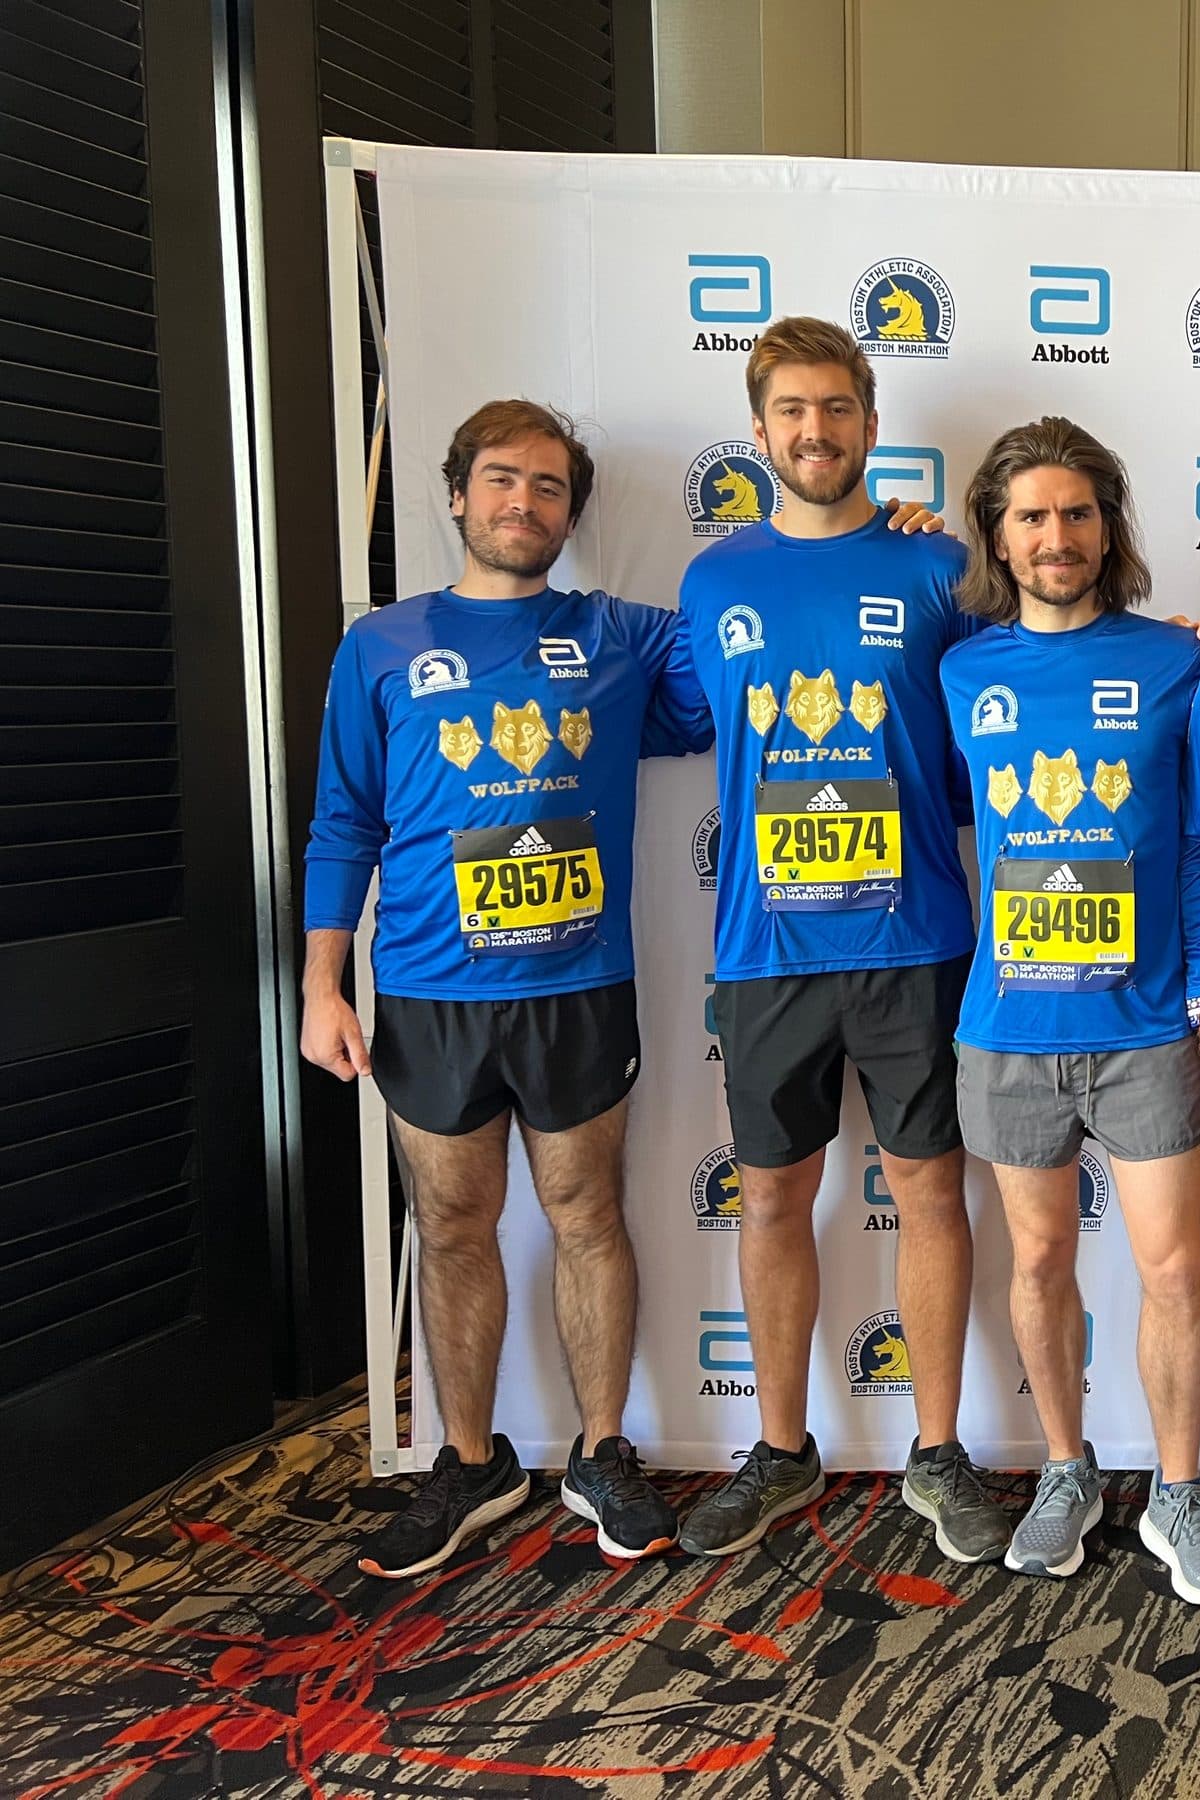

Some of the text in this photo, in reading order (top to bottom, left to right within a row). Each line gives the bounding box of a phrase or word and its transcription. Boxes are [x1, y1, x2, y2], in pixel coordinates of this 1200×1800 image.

[853, 261, 952, 336] BOSTON ATHLETIC ASSOCIATION
[692, 332, 759, 352] Abbo
[858, 342, 949, 355] BOSTON MARATHON
[1031, 344, 1110, 365] Abbott
[688, 472, 701, 514] BOSTON
[698, 444, 748, 469] ATHLETIC
[692, 523, 729, 534] BOSTON
[860, 635, 904, 649] Abbott
[549, 667, 589, 679] Abbott
[1093, 719, 1139, 730] Abbott
[763, 747, 872, 765] WOLFPACK
[467, 775, 579, 799] WOLFPACK
[806, 801, 848, 811] adidas
[770, 816, 888, 863] 29574
[1007, 828, 1114, 847] WOLFPACK
[509, 843, 553, 856] adidas
[696, 827, 710, 869] BOSTON
[764, 866, 799, 880] 6 V
[472, 854, 592, 911] 29575
[699, 879, 717, 887] BOS
[1042, 882, 1084, 892] adidas
[786, 891, 845, 900] MARATHON
[467, 914, 499, 927] 6 V
[1007, 896, 1121, 943] 29496
[513, 927, 551, 938] BOSTON
[491, 935, 552, 947] MARATHON
[999, 943, 1034, 958] 6 V
[1019, 971, 1076, 981] MARATHON
[1039, 965, 1075, 973] BOSTON
[694, 1146, 736, 1210] BOSTON ATHLE
[1080, 1153, 1106, 1211] SSOCIATION
[697, 1219, 732, 1228] BOSTON
[849, 1313, 900, 1377] BOSTON ATHLETI
[699, 1379, 757, 1396] Abbo
[851, 1384, 913, 1393] BOSTON MARA
